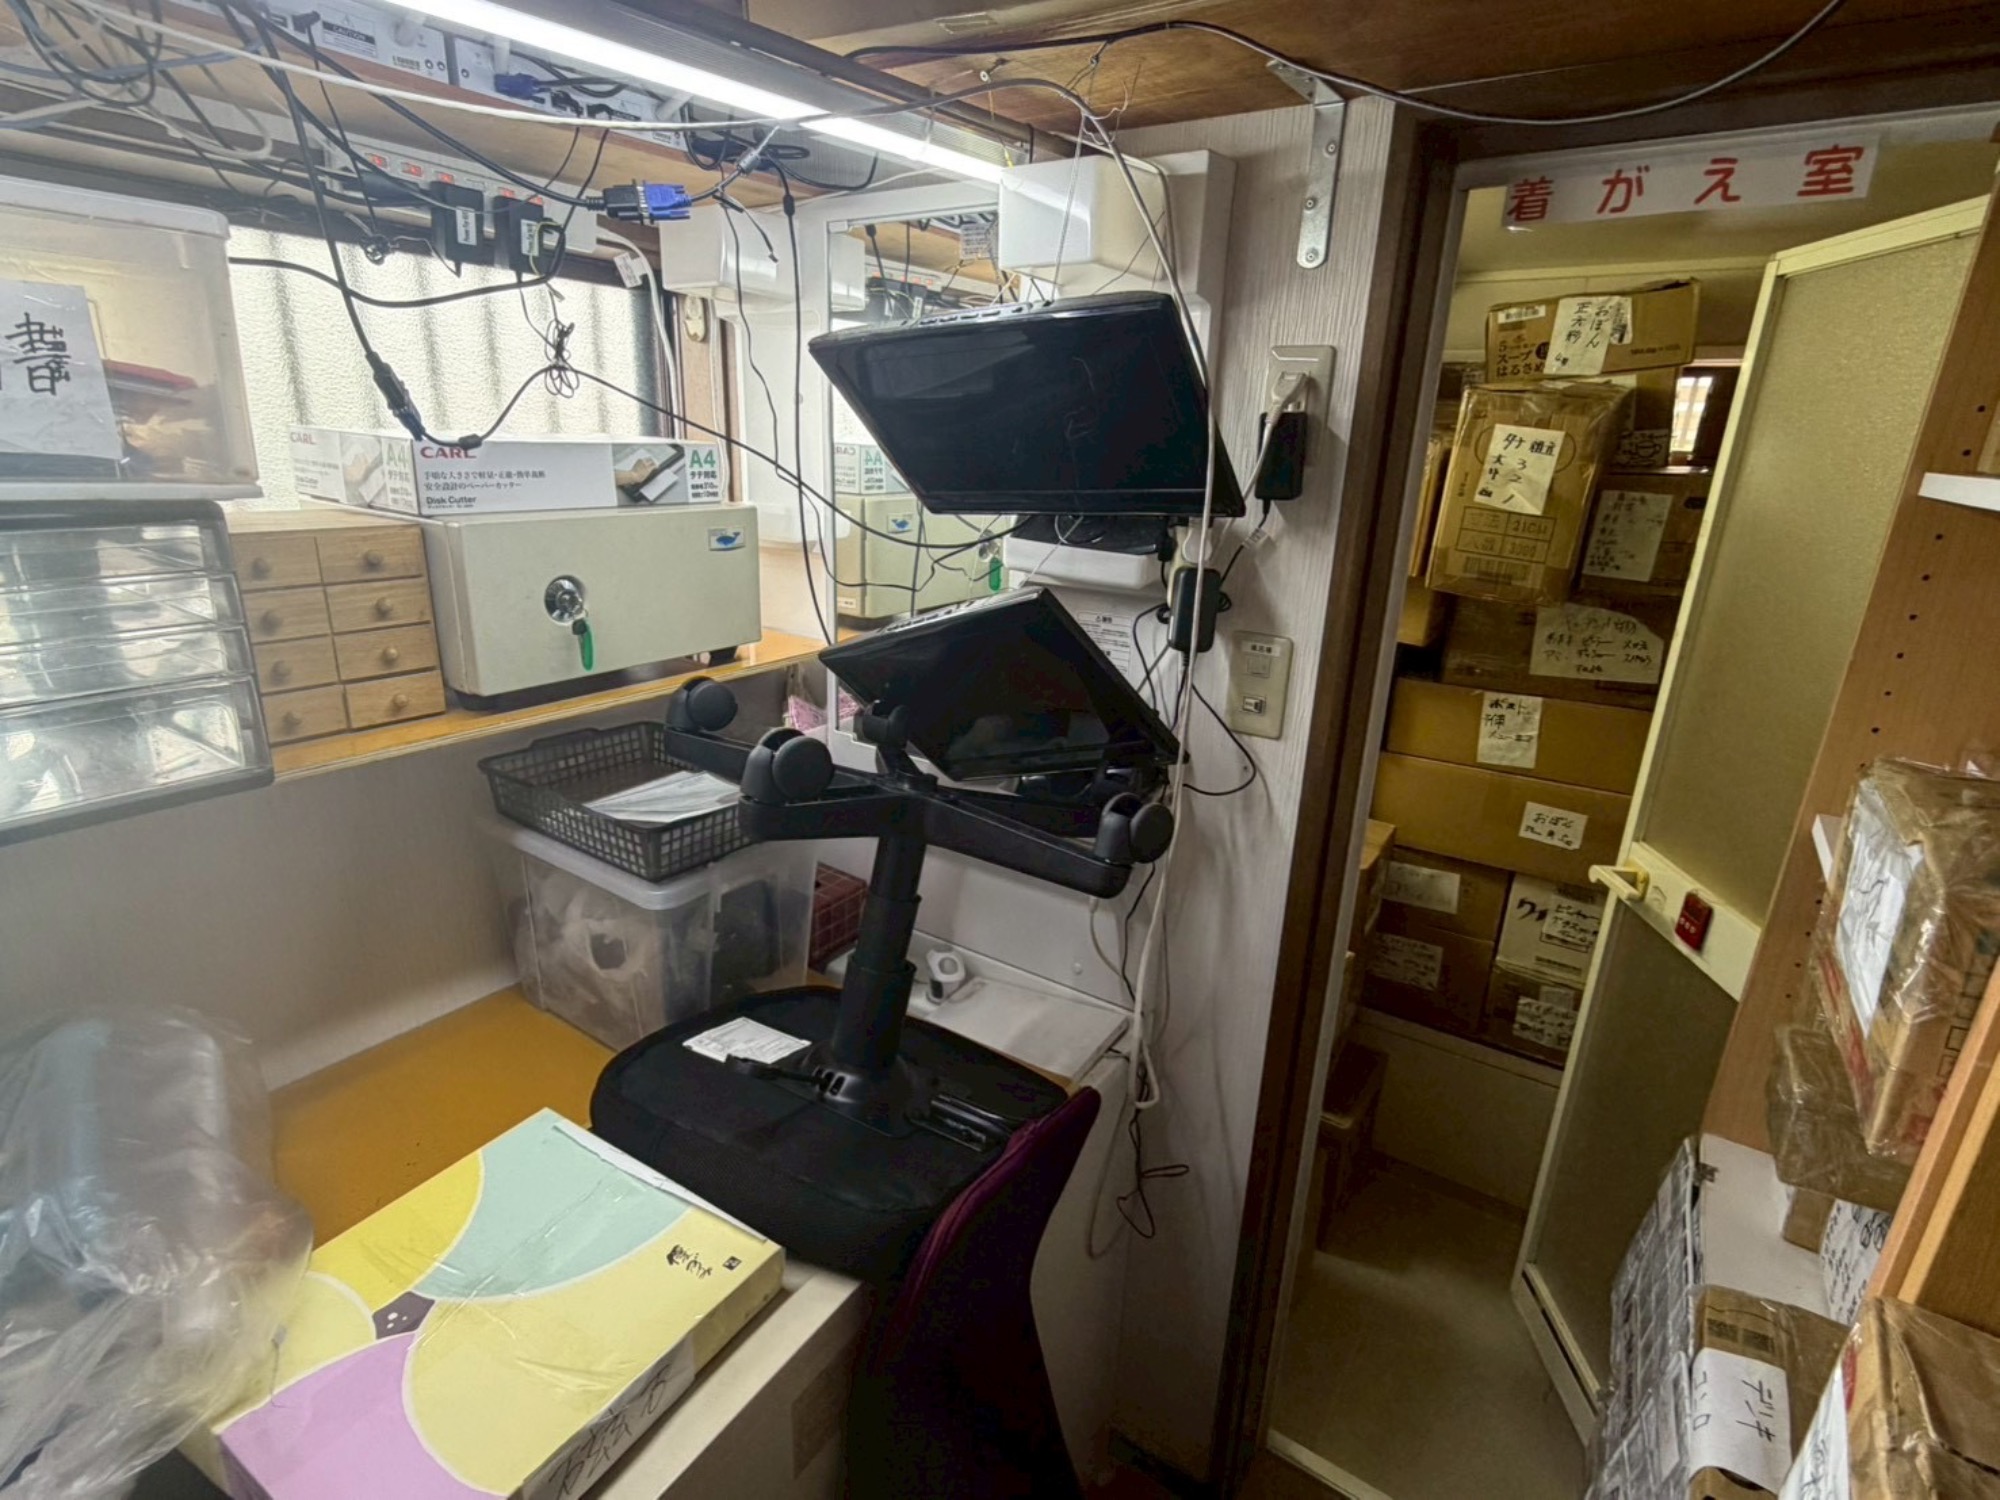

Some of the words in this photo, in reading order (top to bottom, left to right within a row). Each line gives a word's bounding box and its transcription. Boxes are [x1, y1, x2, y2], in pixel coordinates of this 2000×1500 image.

[1507, 144, 1864, 222] 着がえ室
[420, 446, 477, 459] CARL
[689, 449, 717, 468] A4
[426, 496, 447, 505] Disk
[448, 496, 477, 504] Cutter
[1736, 1379, 1776, 1442] デンキ
